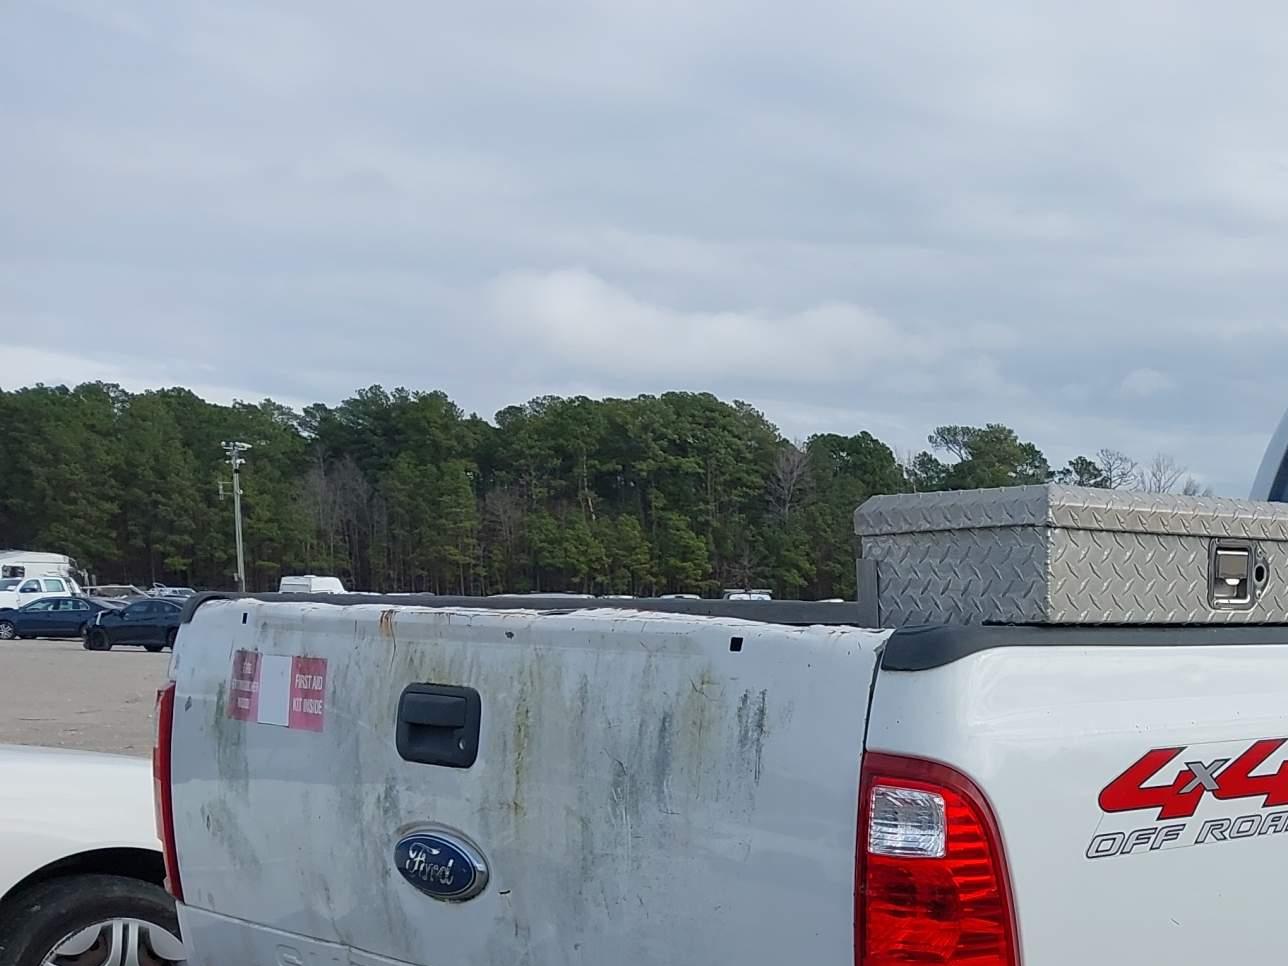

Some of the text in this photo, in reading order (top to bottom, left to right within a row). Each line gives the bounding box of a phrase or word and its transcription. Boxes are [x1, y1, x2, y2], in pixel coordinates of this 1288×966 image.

[295, 674, 323, 690] FIRST AID
[292, 698, 322, 714] KIT INSIDE
[1086, 823, 1186, 859] OFF
[405, 842, 455, 886] Ford
